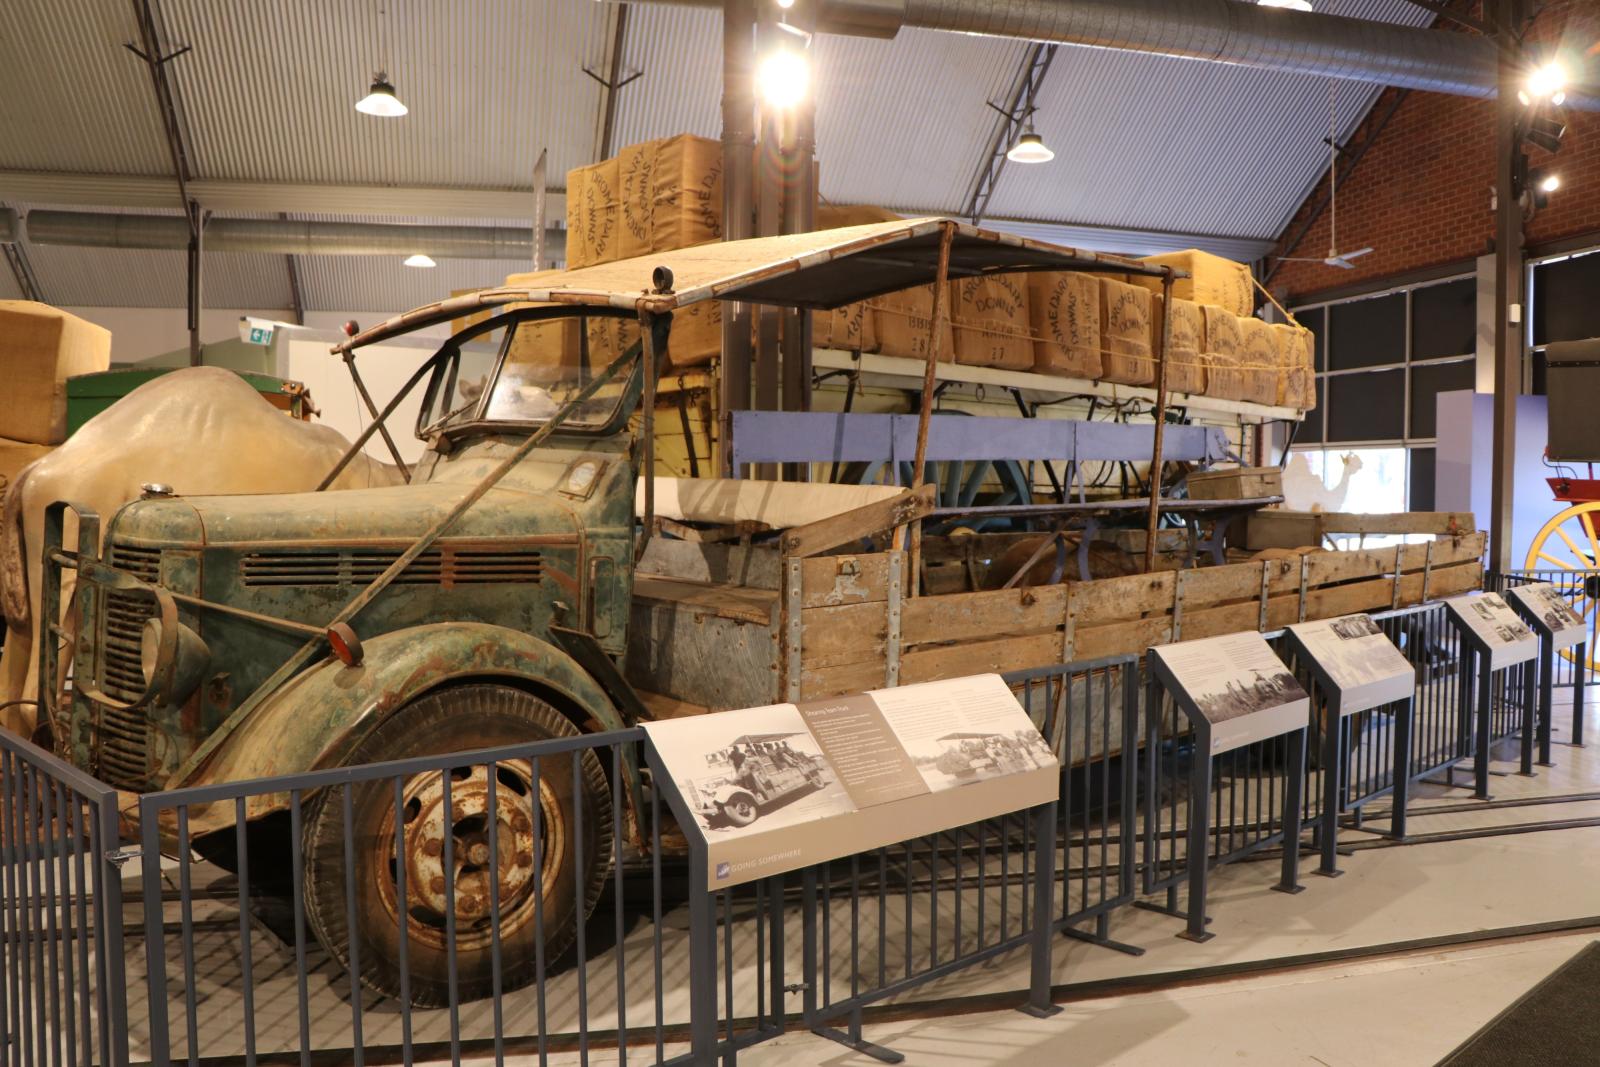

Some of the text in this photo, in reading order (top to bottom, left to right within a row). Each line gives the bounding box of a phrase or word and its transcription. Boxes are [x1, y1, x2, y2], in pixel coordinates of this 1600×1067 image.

[976, 297, 1016, 318] DOWNS
[730, 847, 802, 873] GOING SOMEWHERE
